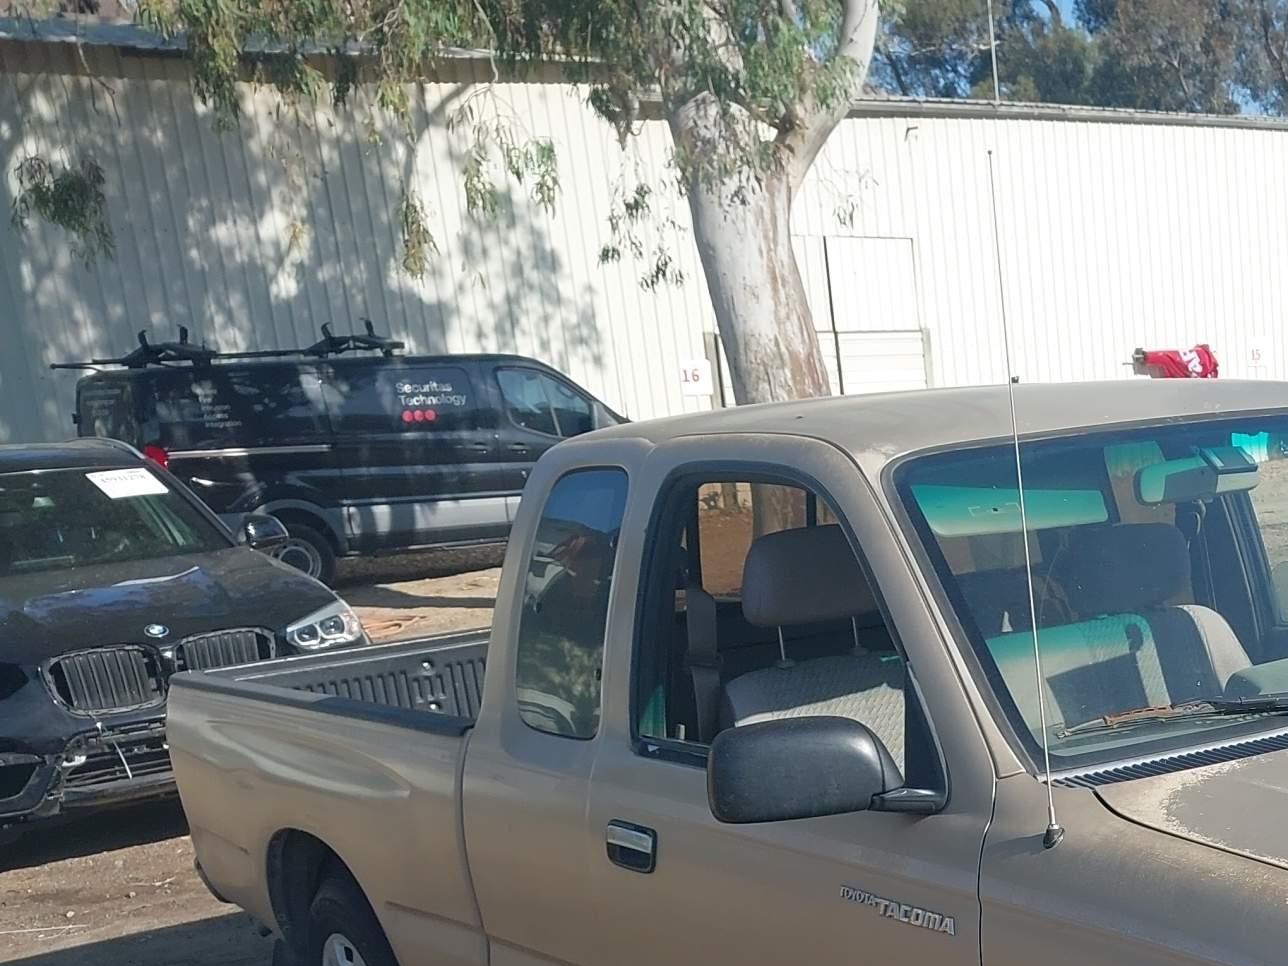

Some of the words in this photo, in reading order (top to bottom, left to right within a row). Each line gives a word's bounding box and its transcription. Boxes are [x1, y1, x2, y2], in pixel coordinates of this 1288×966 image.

[1251, 348, 1261, 360] 15
[682, 368, 700, 382] 16
[395, 381, 453, 394] Securitas
[398, 394, 467, 406] Technology
[839, 885, 877, 907] TOYOTA
[874, 898, 956, 936] TACOMA
